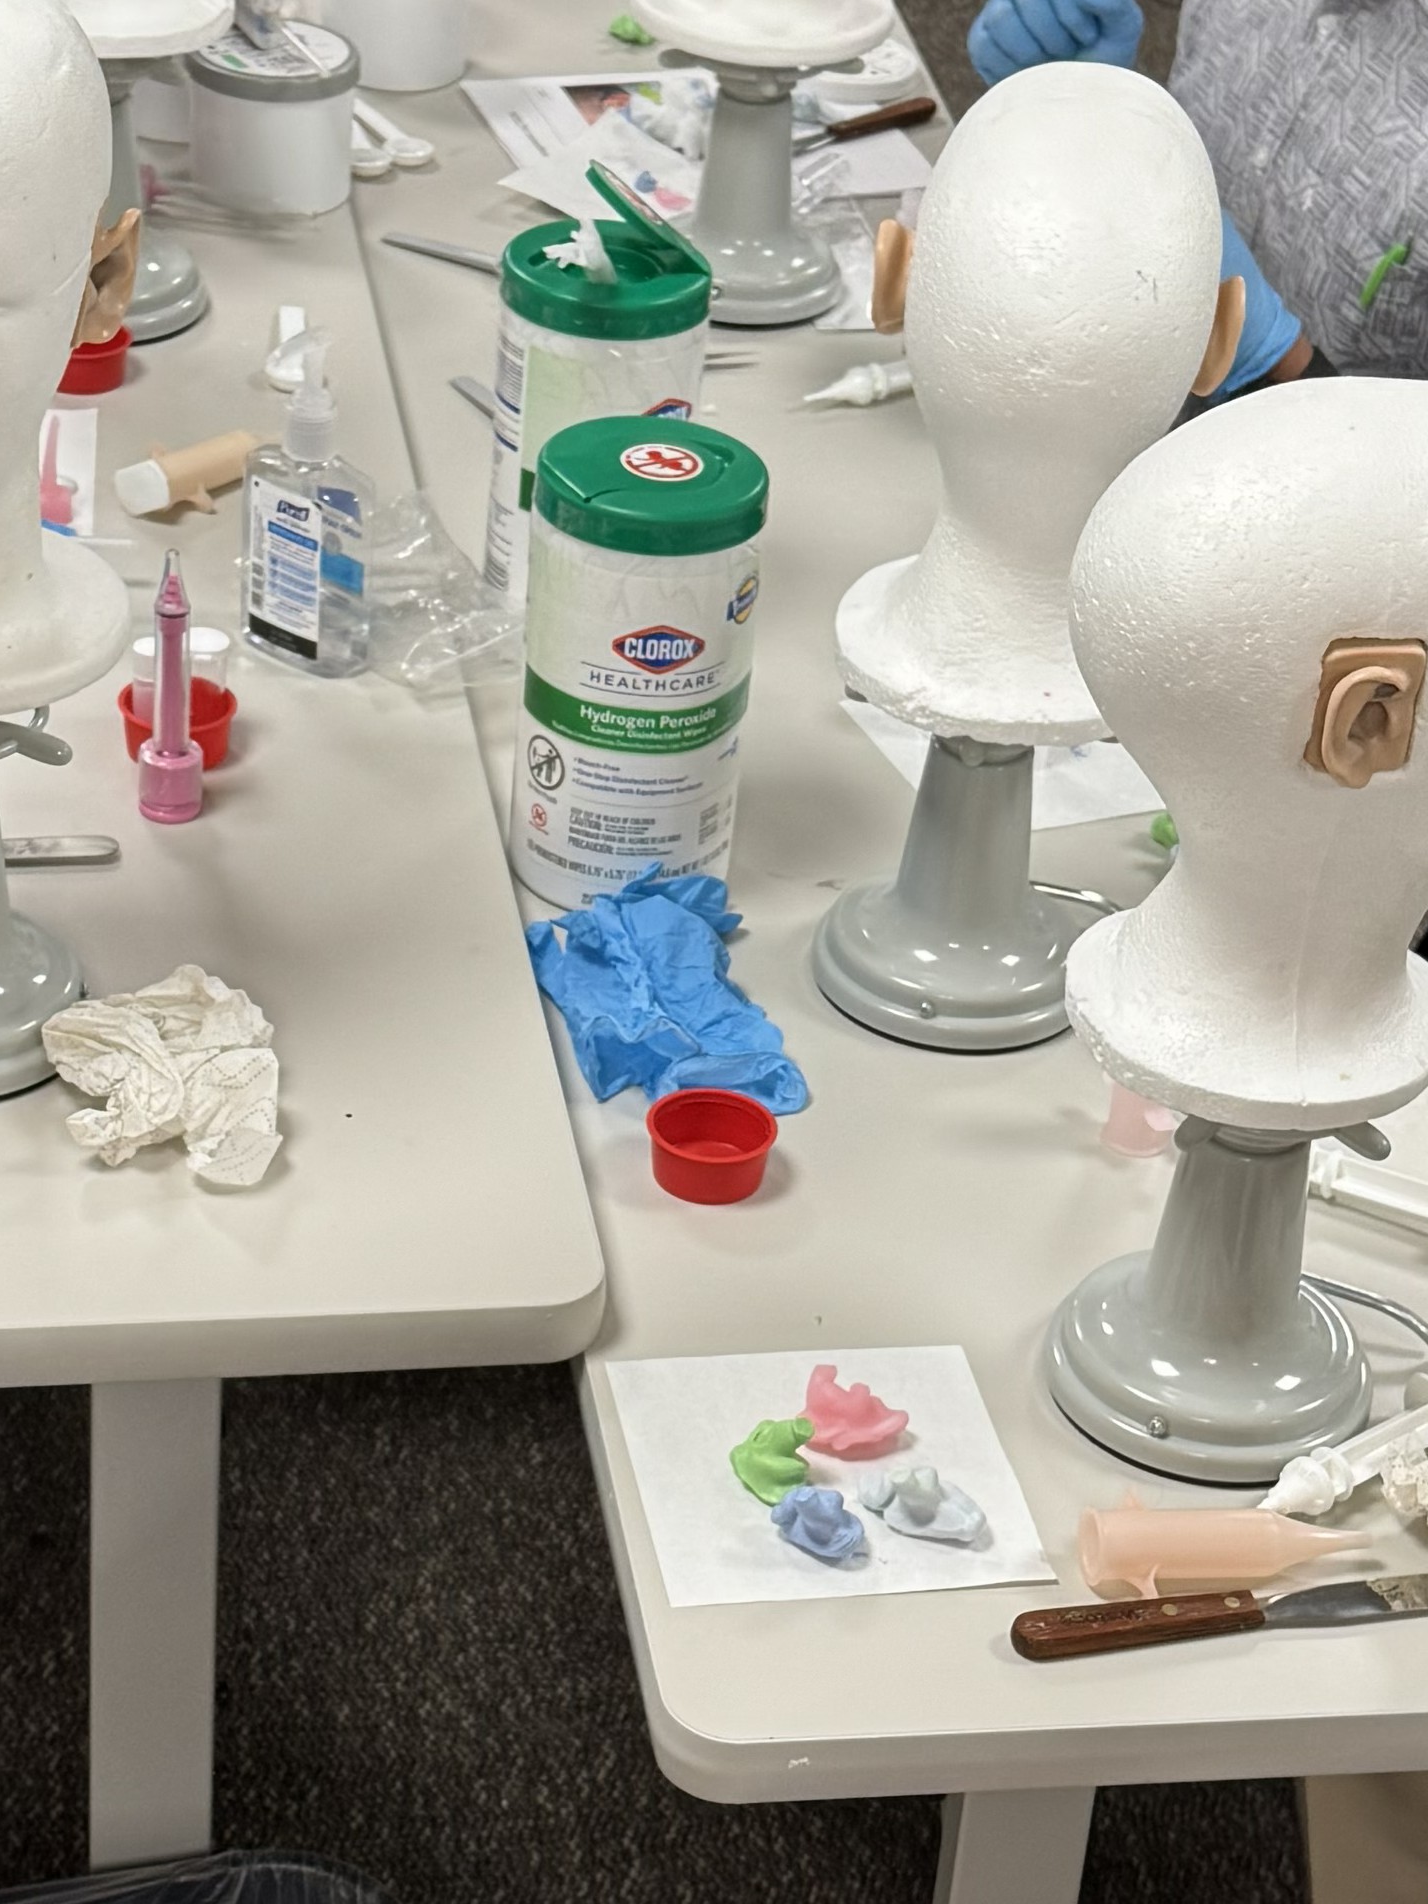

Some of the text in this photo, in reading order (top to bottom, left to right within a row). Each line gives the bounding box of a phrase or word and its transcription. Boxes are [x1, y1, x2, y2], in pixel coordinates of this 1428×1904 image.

[623, 636, 696, 661] CLOROX
[589, 670, 717, 692] HEALTHCARE
[580, 704, 717, 729] Hydrogen Peroxide
